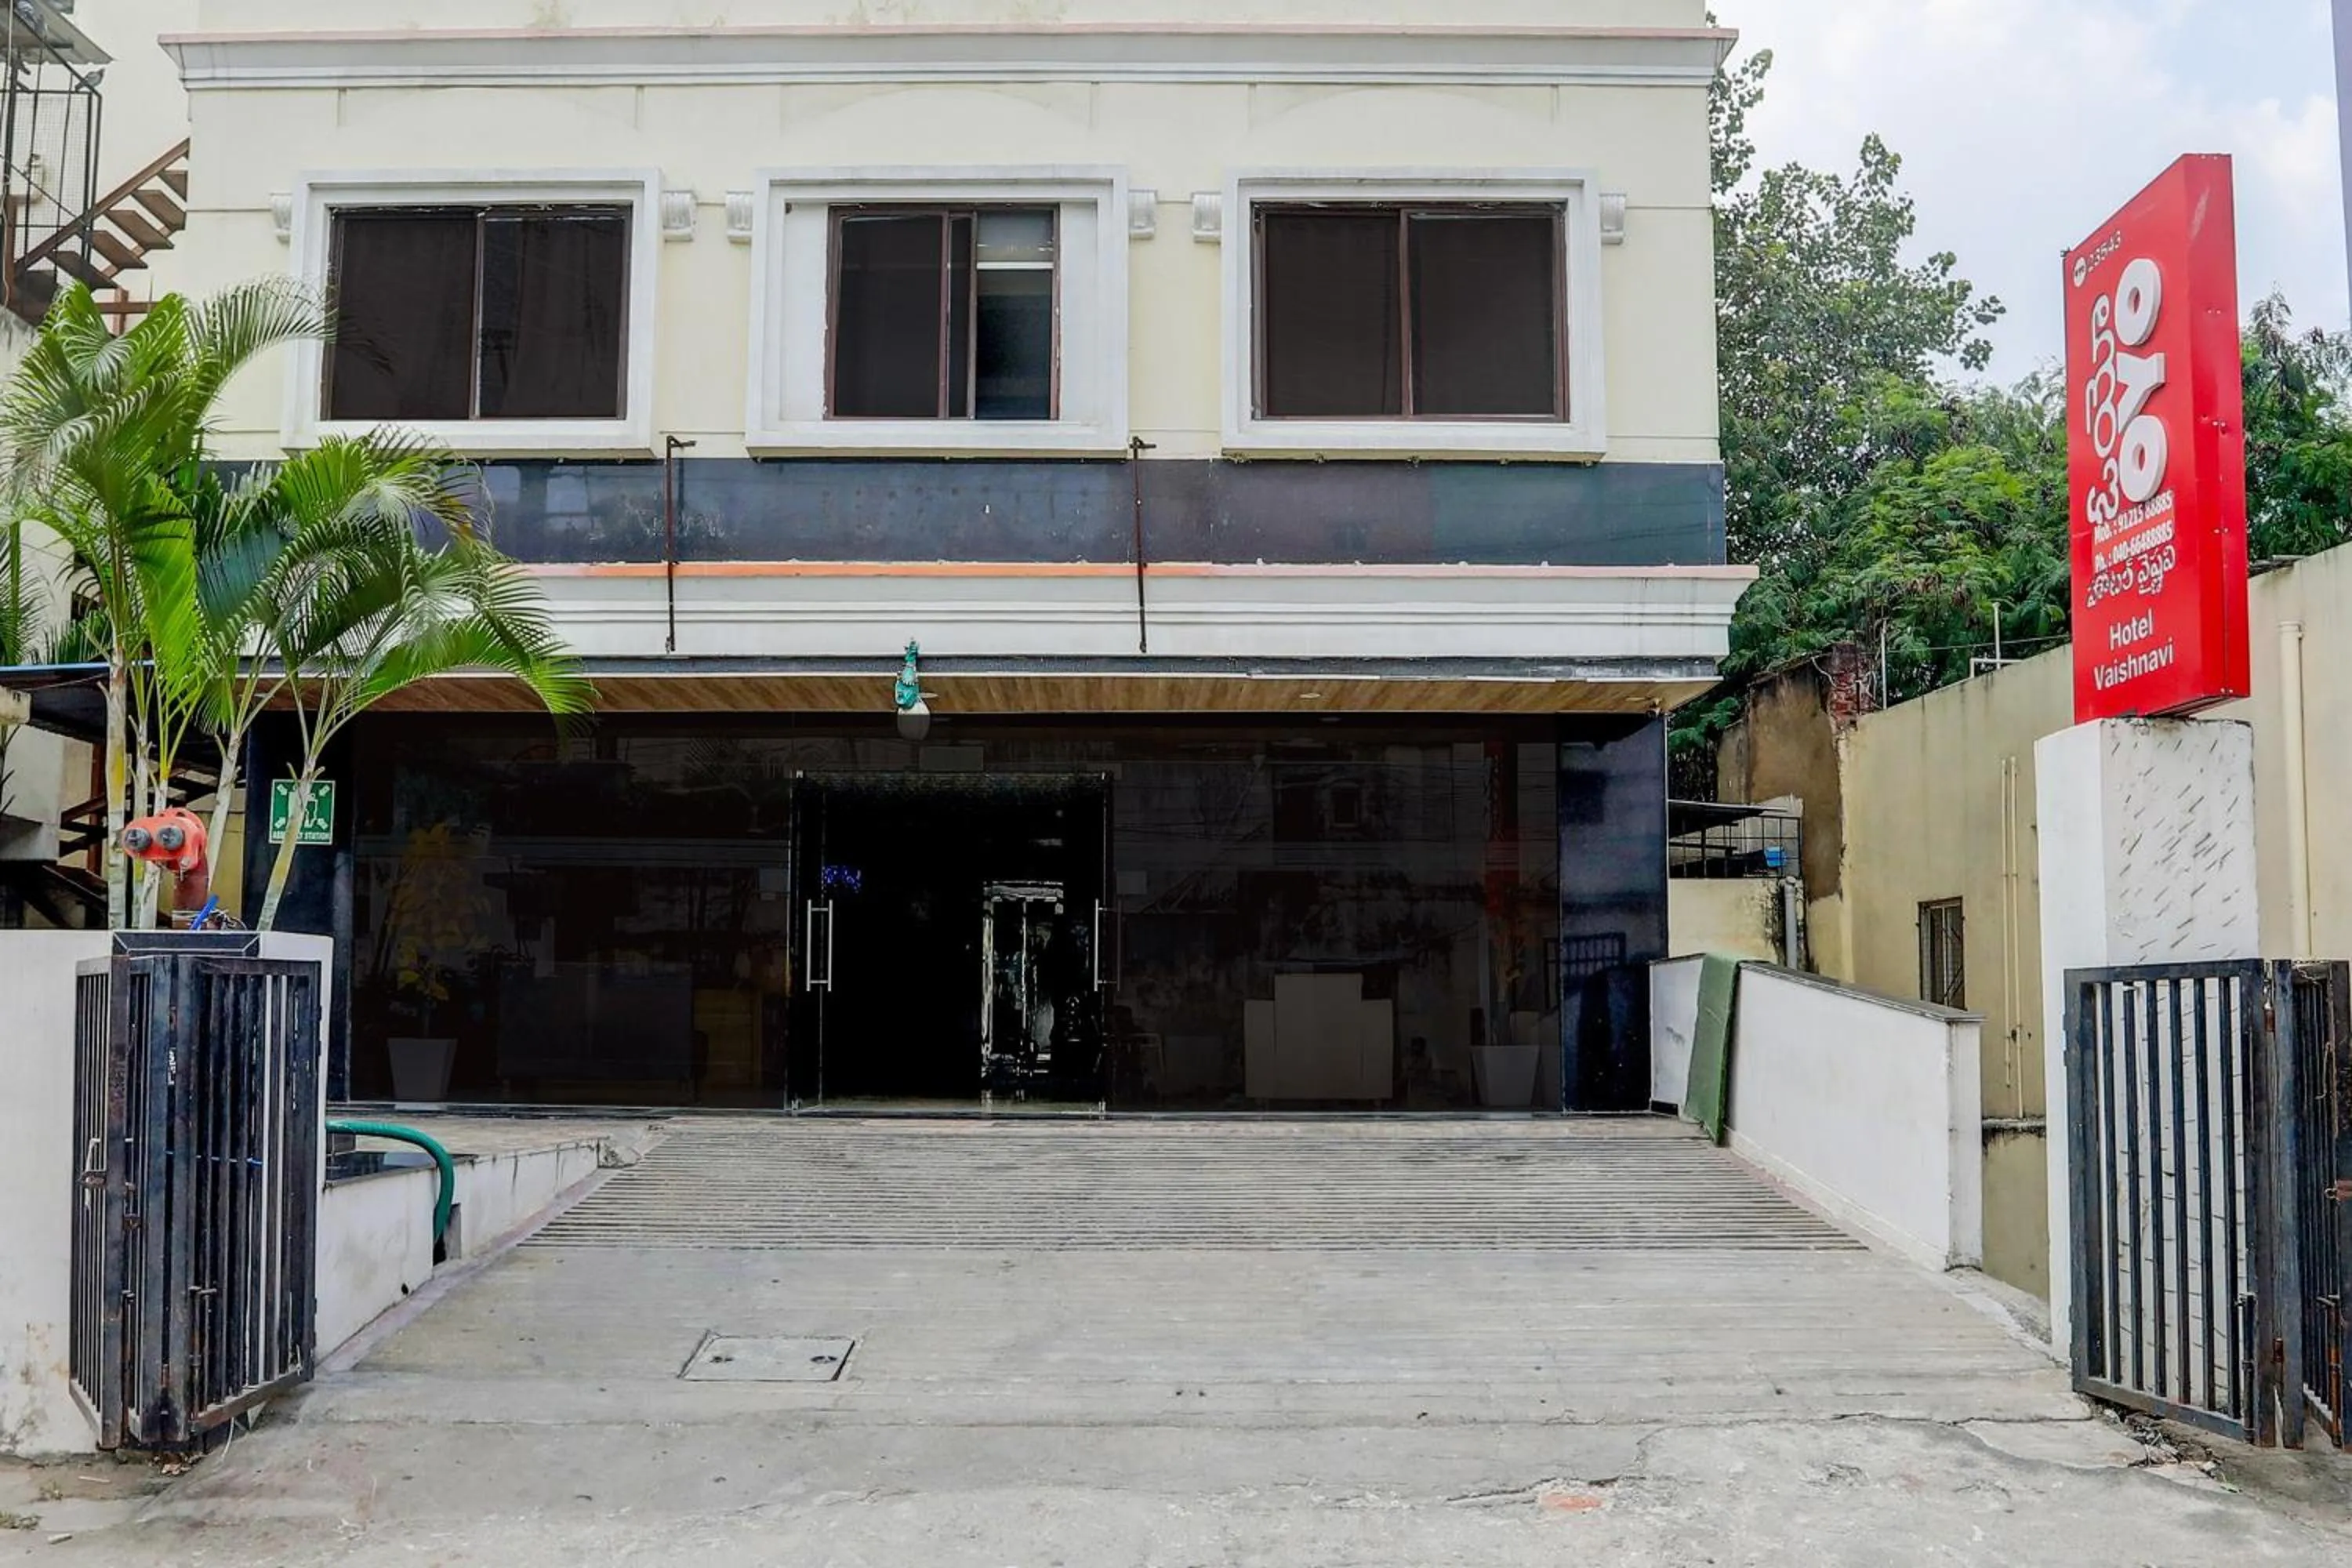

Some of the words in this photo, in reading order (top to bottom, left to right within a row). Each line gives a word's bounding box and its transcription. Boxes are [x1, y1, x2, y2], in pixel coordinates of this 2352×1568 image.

[2114, 257, 2167, 503] OYO
[2109, 608, 2153, 650] Hotel
[2094, 637, 2173, 690] Vaishnavi
